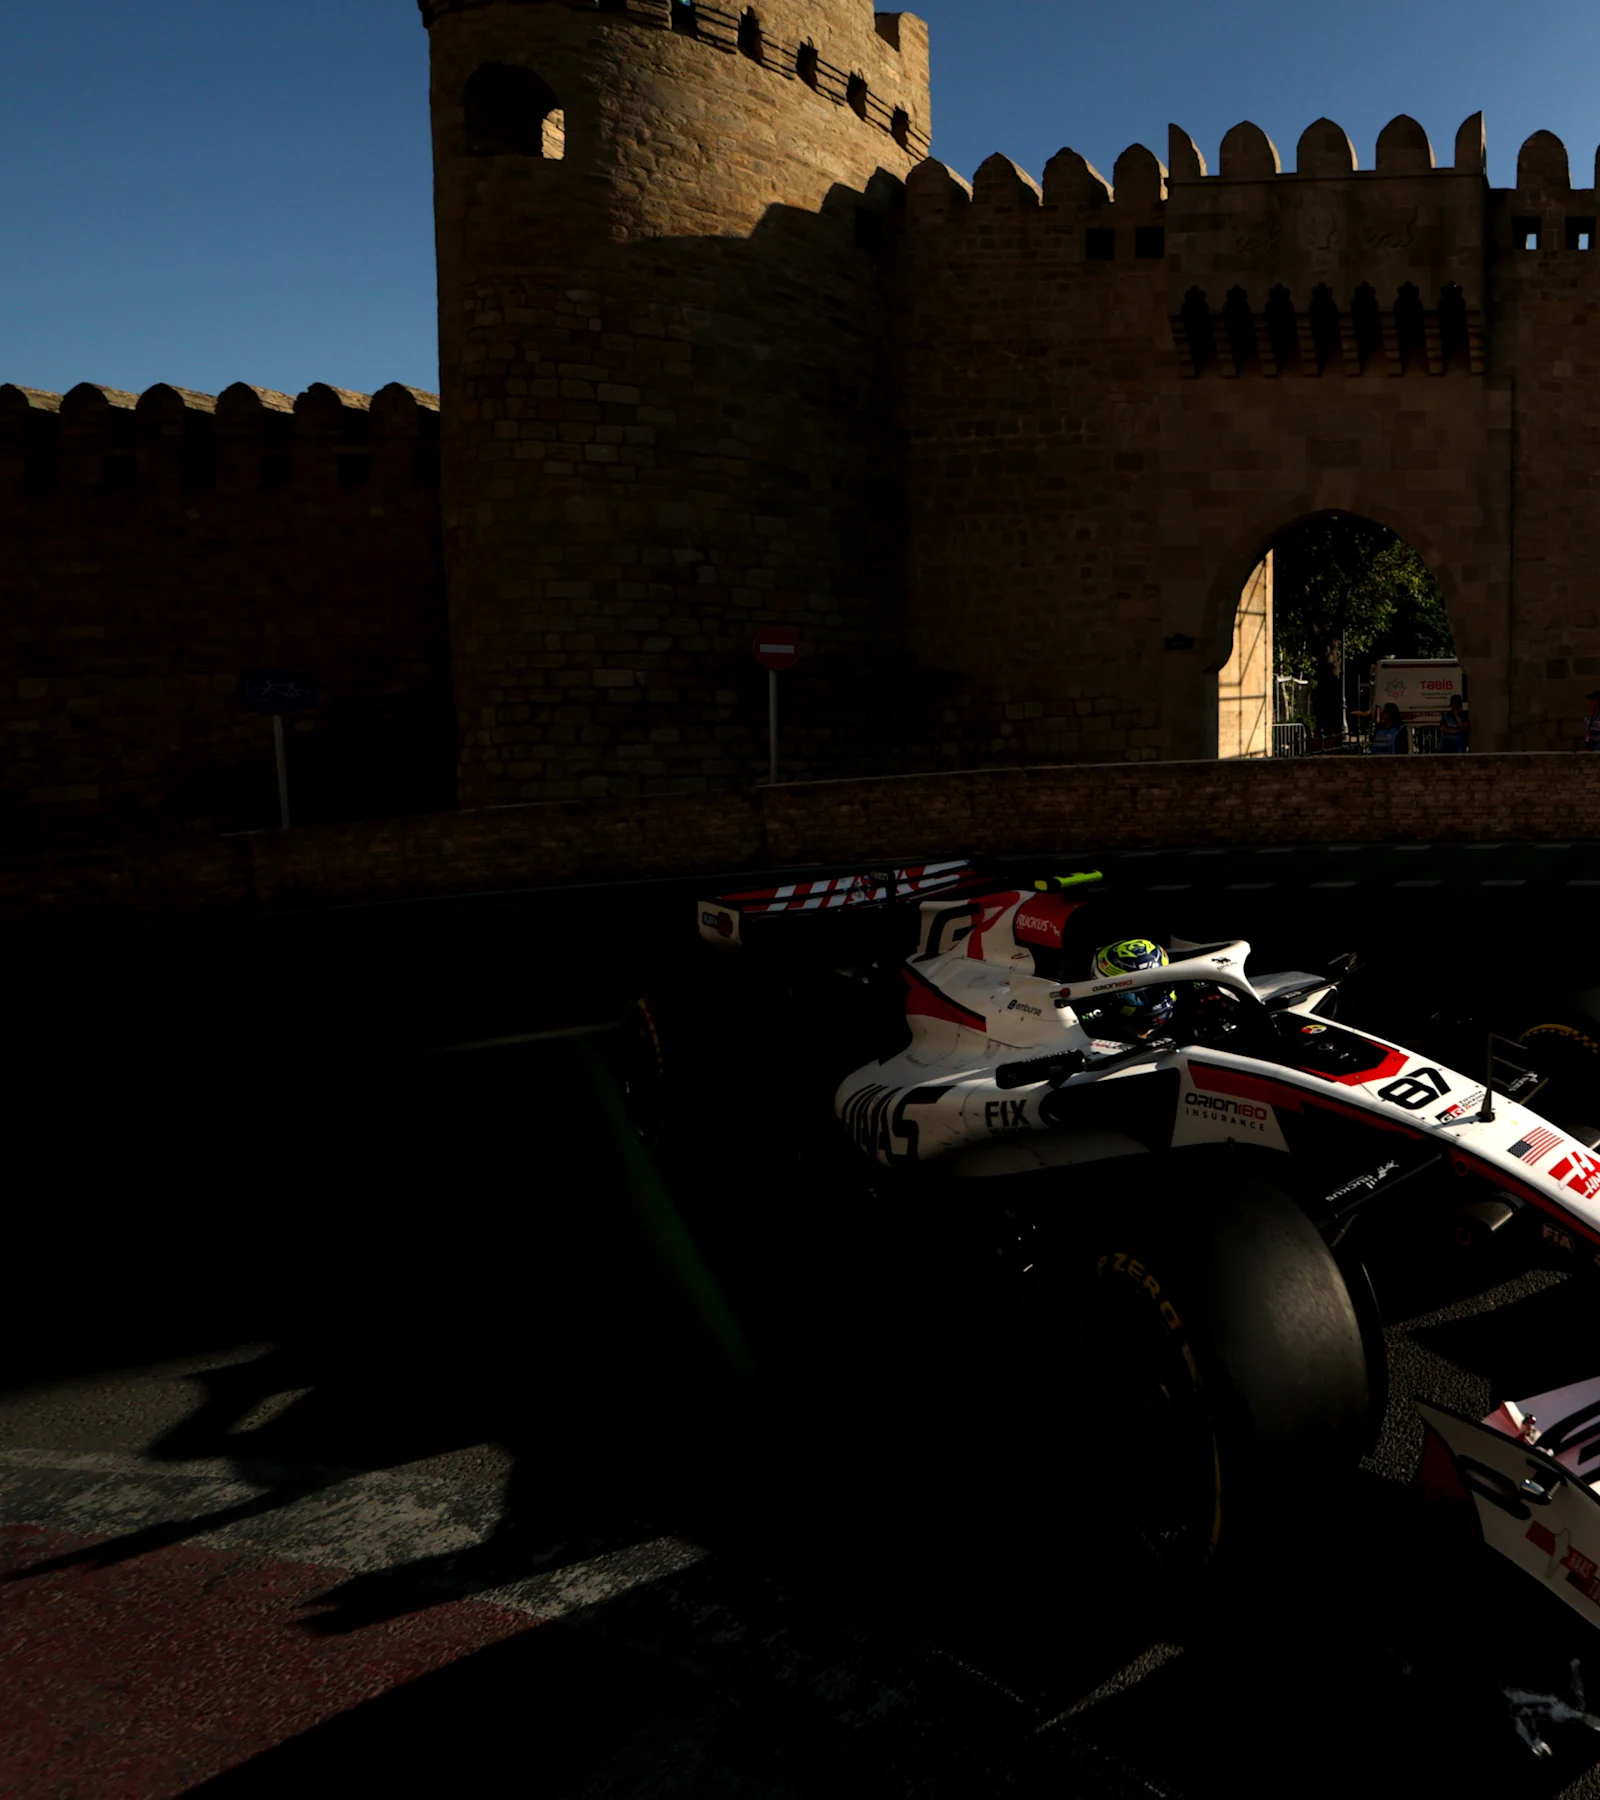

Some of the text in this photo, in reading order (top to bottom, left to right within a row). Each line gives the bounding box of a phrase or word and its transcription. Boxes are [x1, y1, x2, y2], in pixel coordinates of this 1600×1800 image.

[1016, 914, 1050, 932] RUCKUS
[1016, 1001, 1042, 1017] emburse
[1377, 1067, 1452, 1111] 87
[985, 1100, 1030, 1127] FIX
[1185, 1093, 1267, 1120] ORION180
[1186, 1108, 1264, 1131] INSURANCE
[1541, 1222, 1573, 1251] FIA
